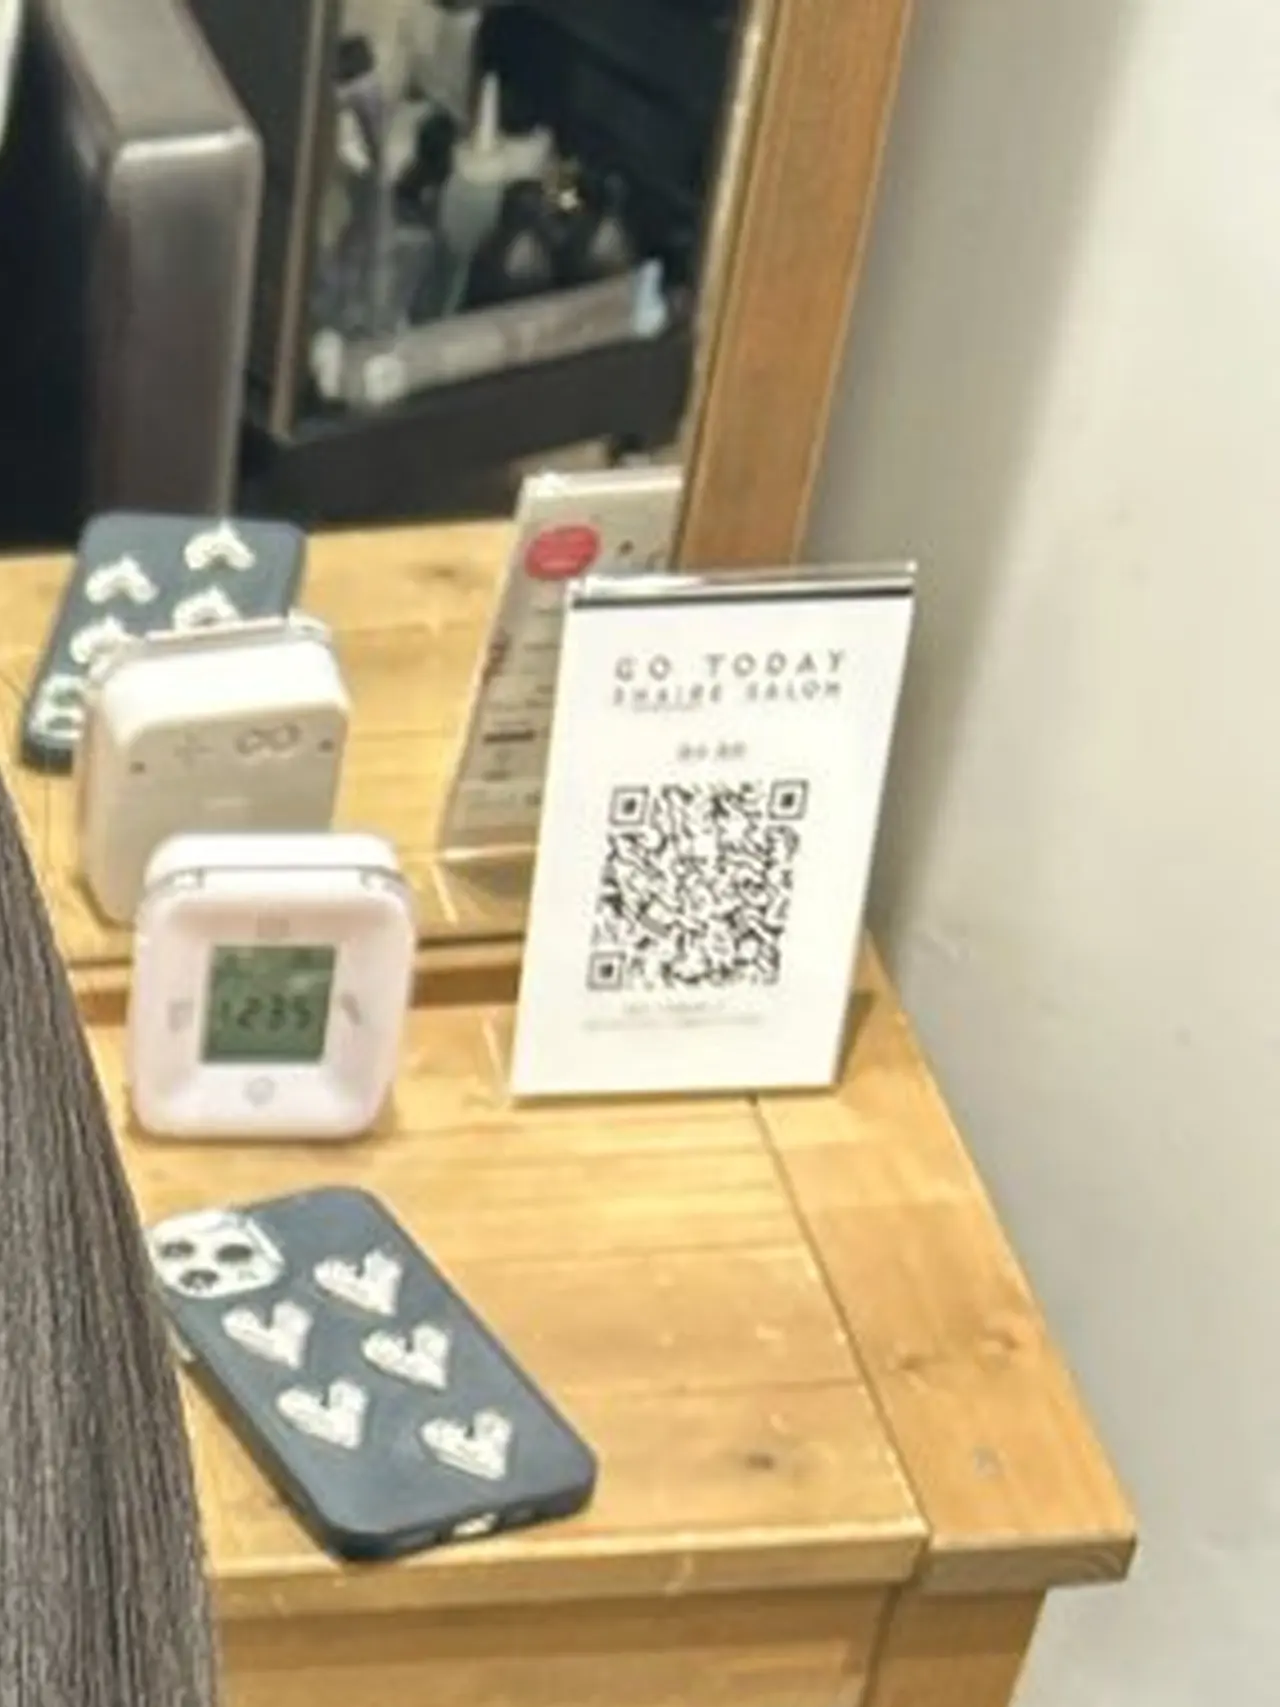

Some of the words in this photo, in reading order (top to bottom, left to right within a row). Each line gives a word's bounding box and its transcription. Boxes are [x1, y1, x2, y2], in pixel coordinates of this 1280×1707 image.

[614, 654, 673, 682] GO
[704, 649, 846, 678] TODAY
[746, 680, 842, 701] SALON
